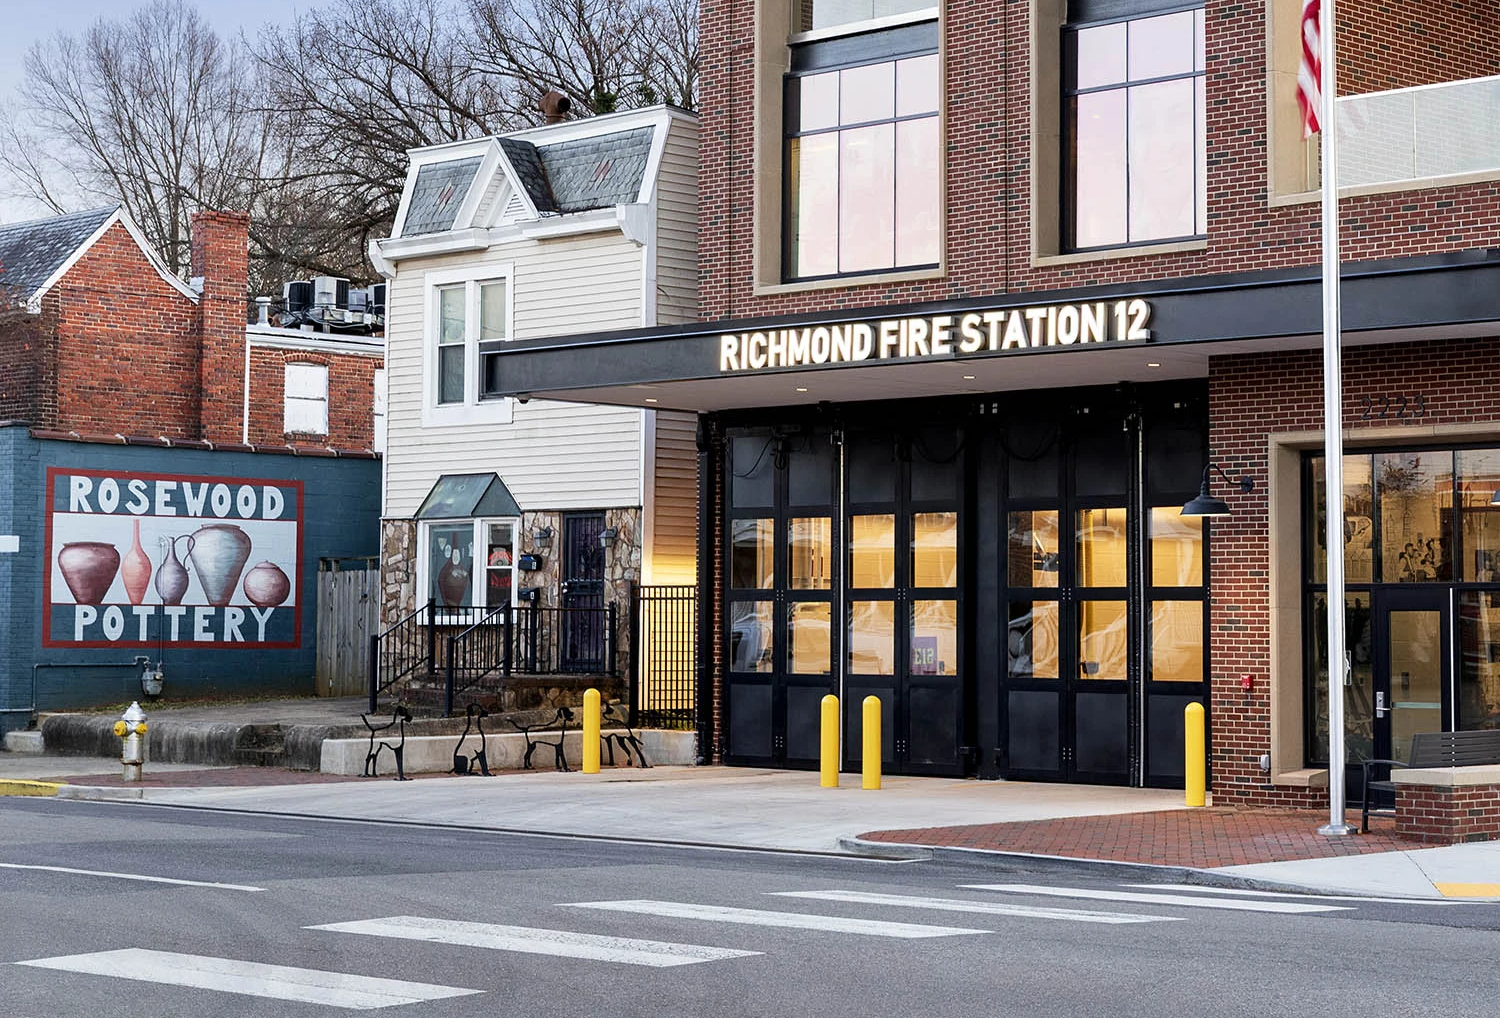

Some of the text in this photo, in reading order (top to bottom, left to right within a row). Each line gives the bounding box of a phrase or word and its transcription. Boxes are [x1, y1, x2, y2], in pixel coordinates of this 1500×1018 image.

[719, 298, 1151, 372] RICHMOND FIRE STATION 12
[1360, 394, 1425, 420] 2223
[69, 475, 285, 520] ROSEWOOD
[74, 605, 275, 643] POTTERY
